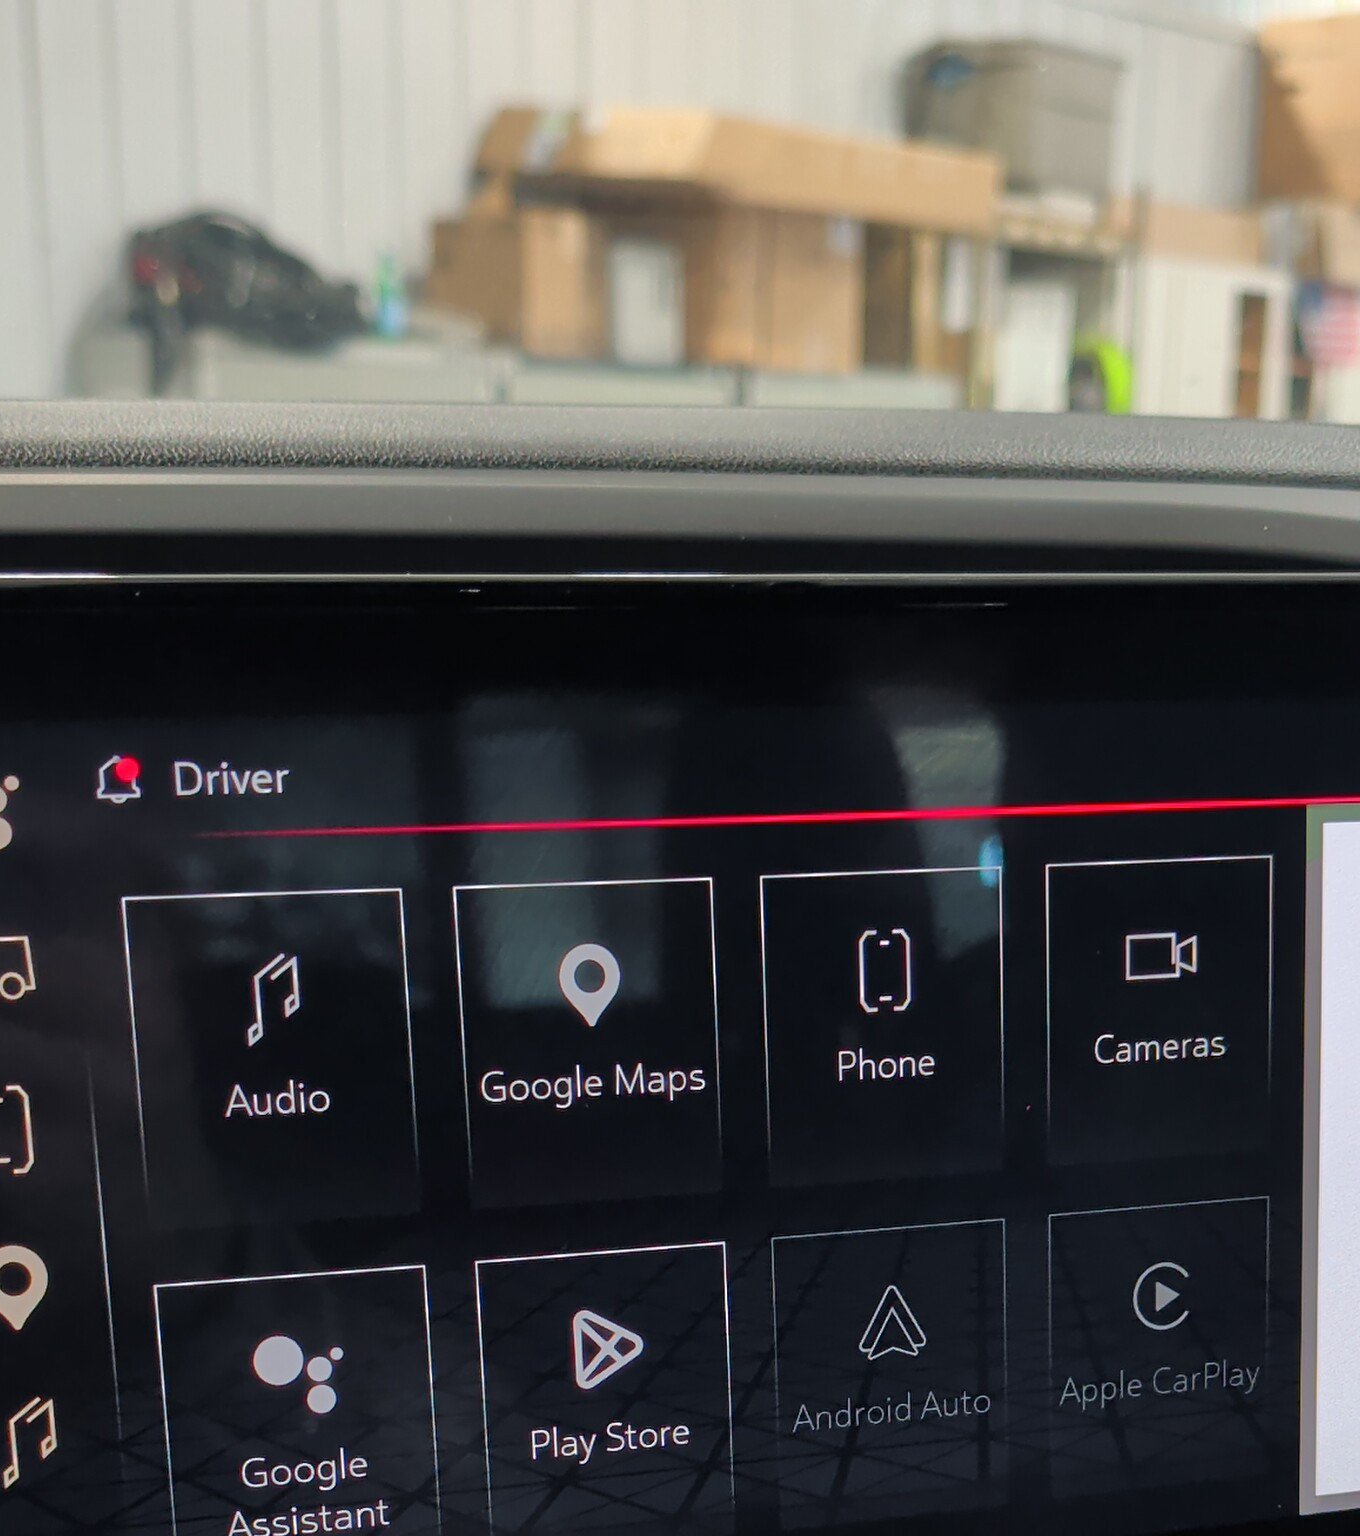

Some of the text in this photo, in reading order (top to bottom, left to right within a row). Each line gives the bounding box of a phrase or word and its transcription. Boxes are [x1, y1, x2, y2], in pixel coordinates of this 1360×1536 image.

[173, 760, 290, 796] Driver
[837, 1047, 936, 1082] Phone
[1094, 1033, 1226, 1064] Cameras
[225, 1079, 332, 1118] Audio
[480, 1061, 706, 1109] Google Maps
[1059, 1359, 1261, 1411] Apple CarPlay
[792, 1390, 992, 1433] Android Auto
[530, 1421, 691, 1465] Play Store
[240, 1446, 369, 1492] Google
